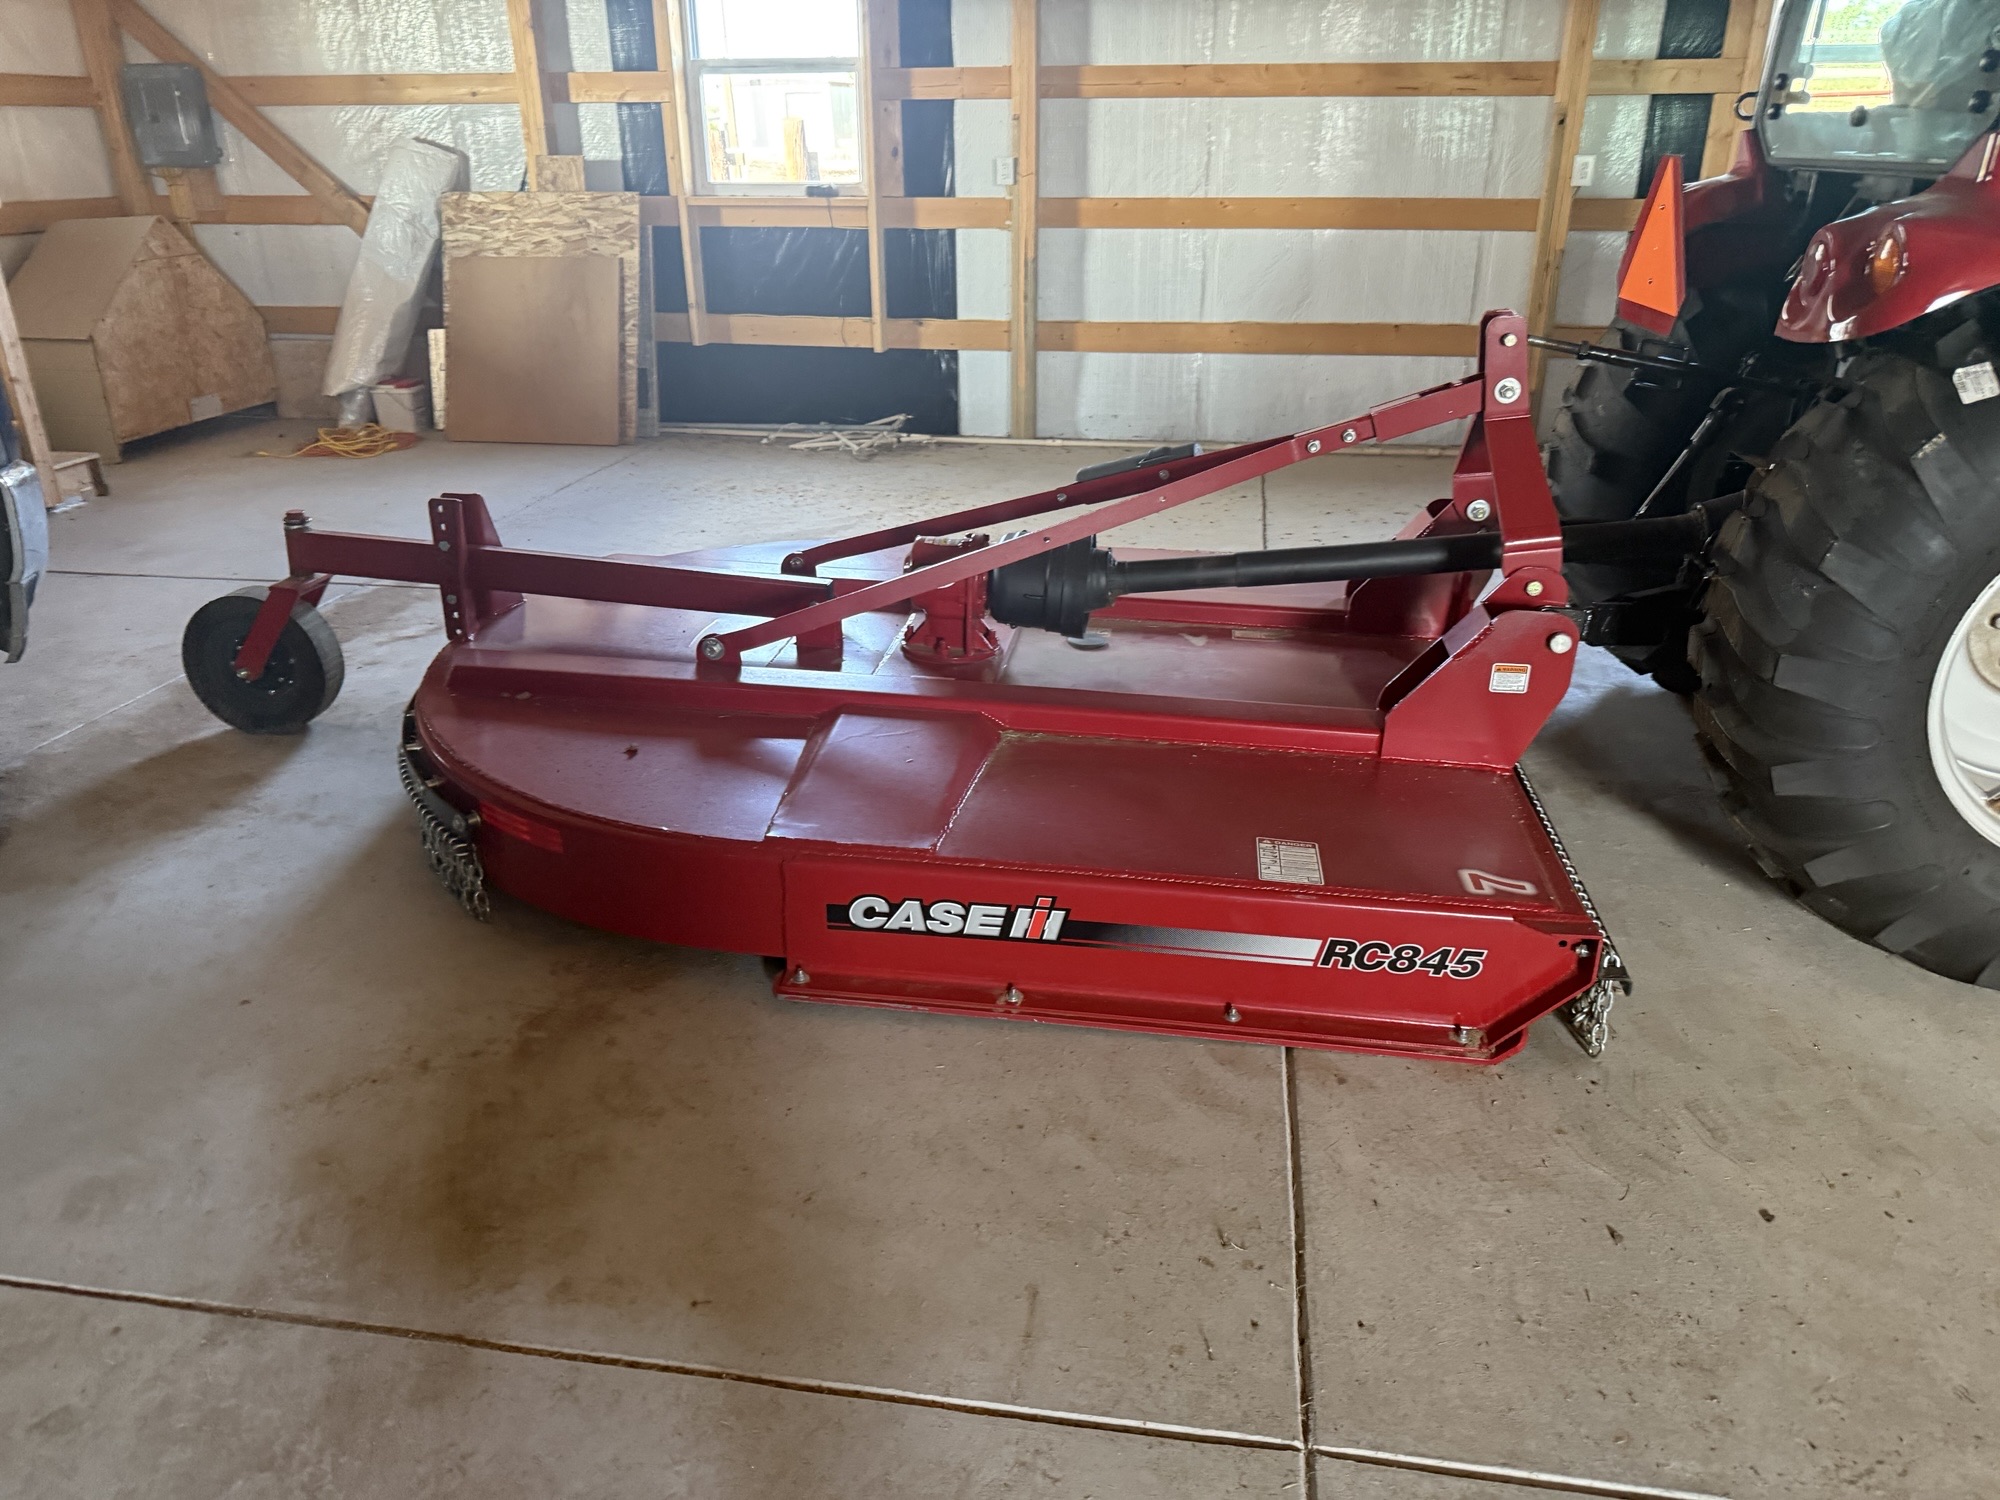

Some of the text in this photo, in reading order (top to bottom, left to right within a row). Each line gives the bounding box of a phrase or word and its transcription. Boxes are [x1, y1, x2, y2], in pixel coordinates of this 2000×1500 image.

[1274, 840, 1313, 848] DANGER
[848, 896, 1008, 937] CASE
[1317, 937, 1488, 980] RC845
